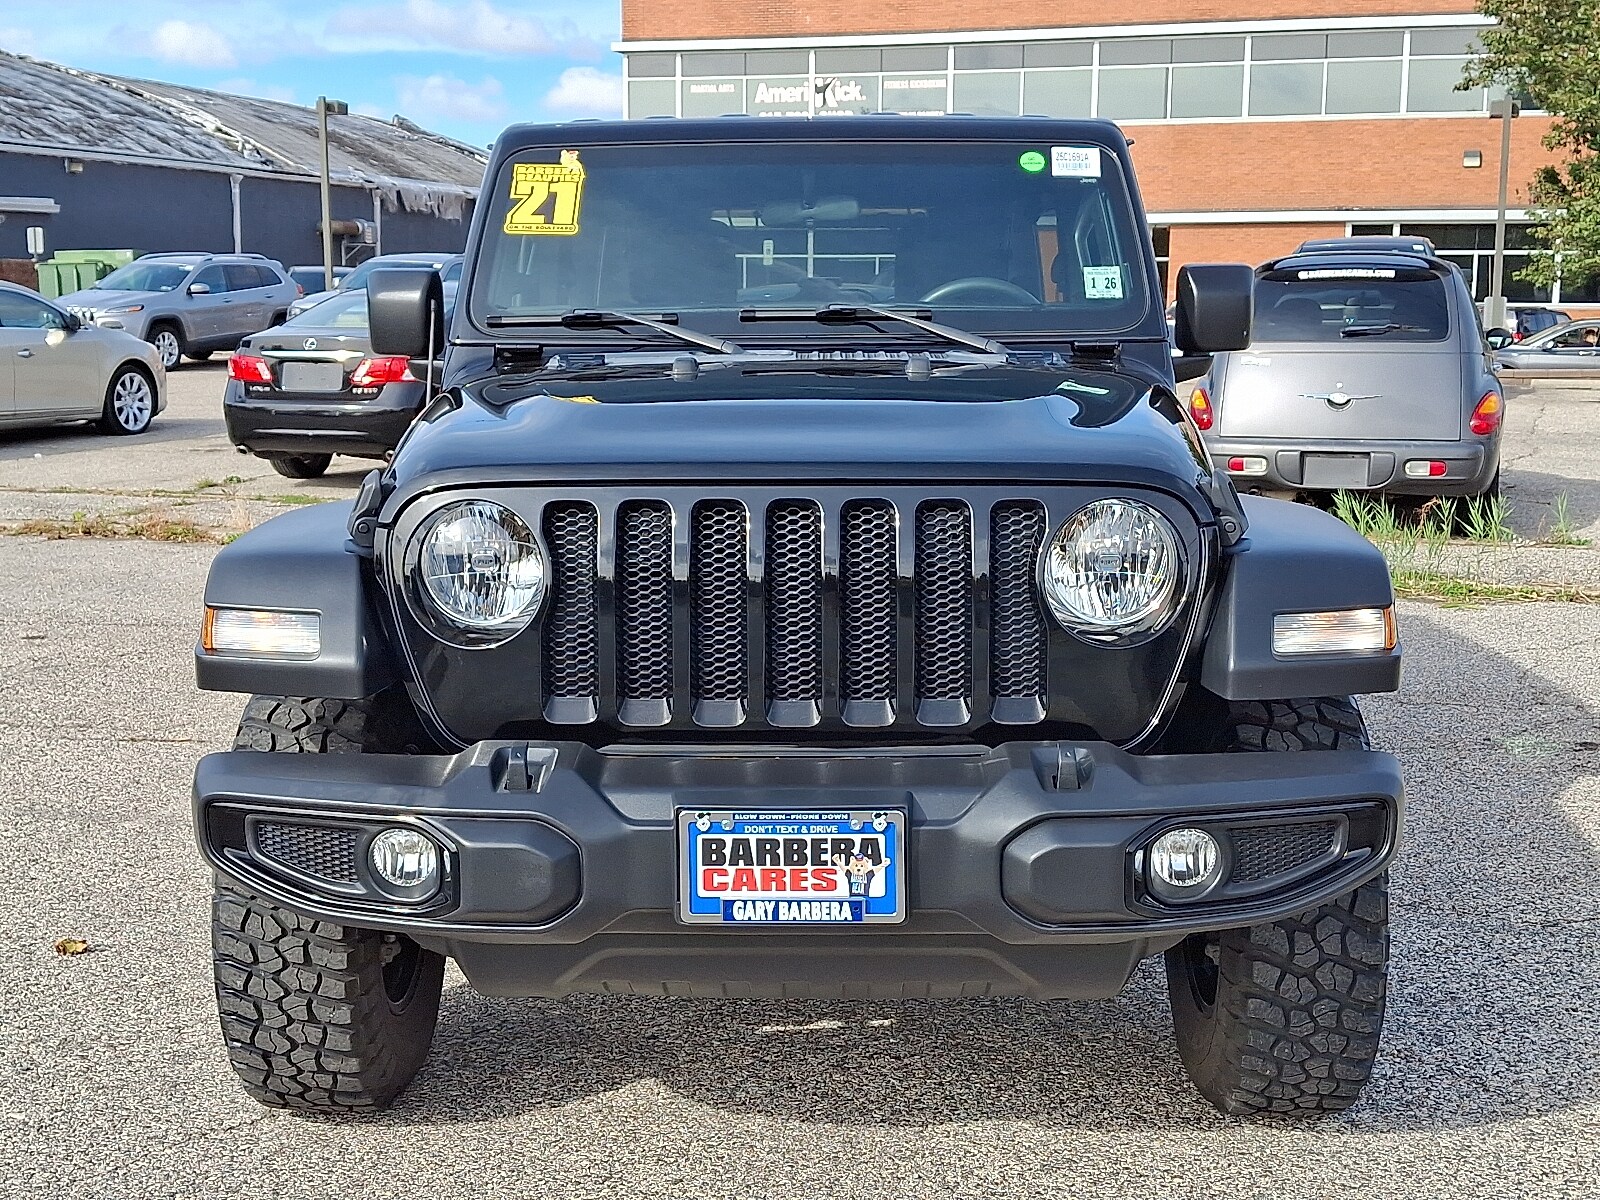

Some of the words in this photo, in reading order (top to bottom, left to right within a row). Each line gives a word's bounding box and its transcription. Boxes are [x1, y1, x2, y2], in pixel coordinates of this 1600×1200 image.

[516, 166, 580, 174] BARBERA
[511, 181, 578, 224] 21
[1091, 277, 1096, 289] 1
[1104, 277, 1117, 289] 26
[744, 825, 773, 833] DON'T
[775, 825, 799, 833] TEXT
[801, 825, 808, 833] &
[810, 825, 838, 833] DRIVE
[701, 838, 882, 866] BARBERA
[702, 868, 837, 891] CARES
[733, 900, 776, 920] GARY
[779, 901, 853, 920] BARBERA
